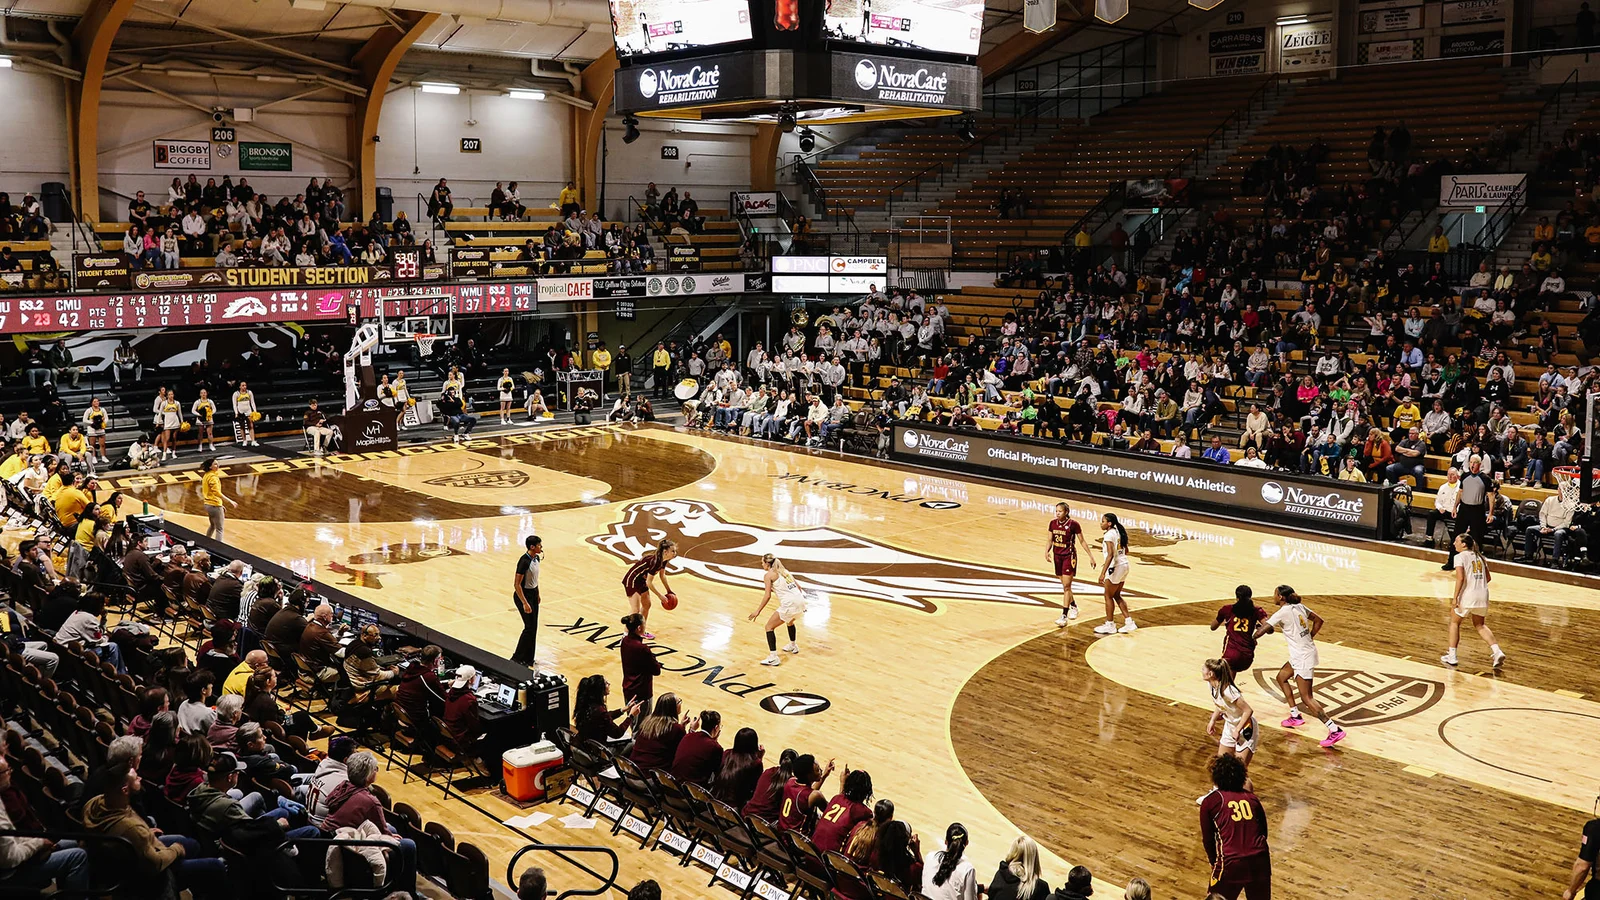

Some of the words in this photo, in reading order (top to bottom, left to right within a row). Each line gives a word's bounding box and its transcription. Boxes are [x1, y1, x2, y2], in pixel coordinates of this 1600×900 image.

[1230, 14, 1242, 22] 210
[1211, 34, 1262, 47] CARRABBA'S
[1216, 57, 1237, 69] WIN
[658, 65, 720, 91] NovaCare
[878, 65, 947, 91] NovaCare
[659, 89, 717, 104] REHABILITATION
[879, 90, 945, 104] REHABILITATION
[215, 131, 233, 140] 206
[170, 146, 209, 154] BIGGBY
[464, 141, 479, 150] 207
[249, 148, 289, 157] BRONSON
[170, 157, 209, 165] COFFEE
[1456, 186, 1484, 199] PARIS
[794, 258, 826, 271] PNC
[227, 268, 300, 287] STUDENT
[306, 267, 369, 285] SECTION
[350, 289, 363, 299] #2
[368, 289, 382, 298] #11
[461, 287, 483, 297] WMU
[514, 286, 532, 295] CMU
[538, 283, 567, 295] tropical
[568, 283, 591, 297] CAFE
[108, 297, 124, 307] #2
[130, 296, 146, 307] #4
[151, 295, 171, 306] #12
[173, 294, 193, 305] #14
[197, 294, 217, 305] #20
[271, 294, 277, 302] 4
[301, 292, 308, 301] 4
[500, 297, 511, 307] 23
[516, 297, 530, 309] 42
[19, 300, 44, 311] 53.2
[56, 300, 82, 311] CMU
[89, 308, 107, 317] PTS
[116, 307, 123, 317] 0
[135, 307, 147, 316] 14
[159, 306, 170, 315] 12
[184, 305, 190, 314] 2
[205, 304, 212, 313] 0
[301, 303, 308, 312] 4
[466, 299, 480, 311] 37
[34, 313, 51, 326] 23
[59, 312, 80, 327] 42
[90, 319, 105, 328] FLS
[116, 318, 123, 328] 2
[138, 318, 145, 327] 2
[162, 317, 168, 326] 0
[185, 316, 190, 325] 1
[205, 315, 212, 324] 2
[366, 425, 381, 436] MH
[252, 439, 498, 474] BRONCOS
[503, 424, 629, 444] FIGHT
[919, 434, 970, 454] NovaCare
[919, 449, 967, 461] REHABILITATION
[988, 448, 1020, 461] Official
[1021, 452, 1058, 468] Physical
[1060, 458, 1099, 474] Therapy
[1102, 464, 1138, 479] Partner
[1140, 469, 1151, 481] of
[1153, 472, 1184, 486] WMU
[1186, 477, 1236, 494] Athletics
[768, 472, 856, 491] BANK
[848, 487, 924, 503] PNC
[1285, 486, 1364, 513] NovaCare
[1285, 505, 1360, 523] REHABILITATION
[1233, 617, 1249, 633] 23
[1298, 614, 1307, 629] 4
[659, 654, 776, 699] PNC
[1376, 696, 1407, 712] 1946
[576, 790, 591, 802] PNC
[605, 806, 619, 817] PNC
[782, 798, 792, 818] 0
[824, 803, 847, 824] 21
[1228, 800, 1253, 822] 30
[632, 821, 647, 834] PNC
[671, 836, 686, 849] PNC
[704, 851, 720, 865] PNC
[729, 871, 746, 886] PNC
[768, 889, 784, 900] PNC
